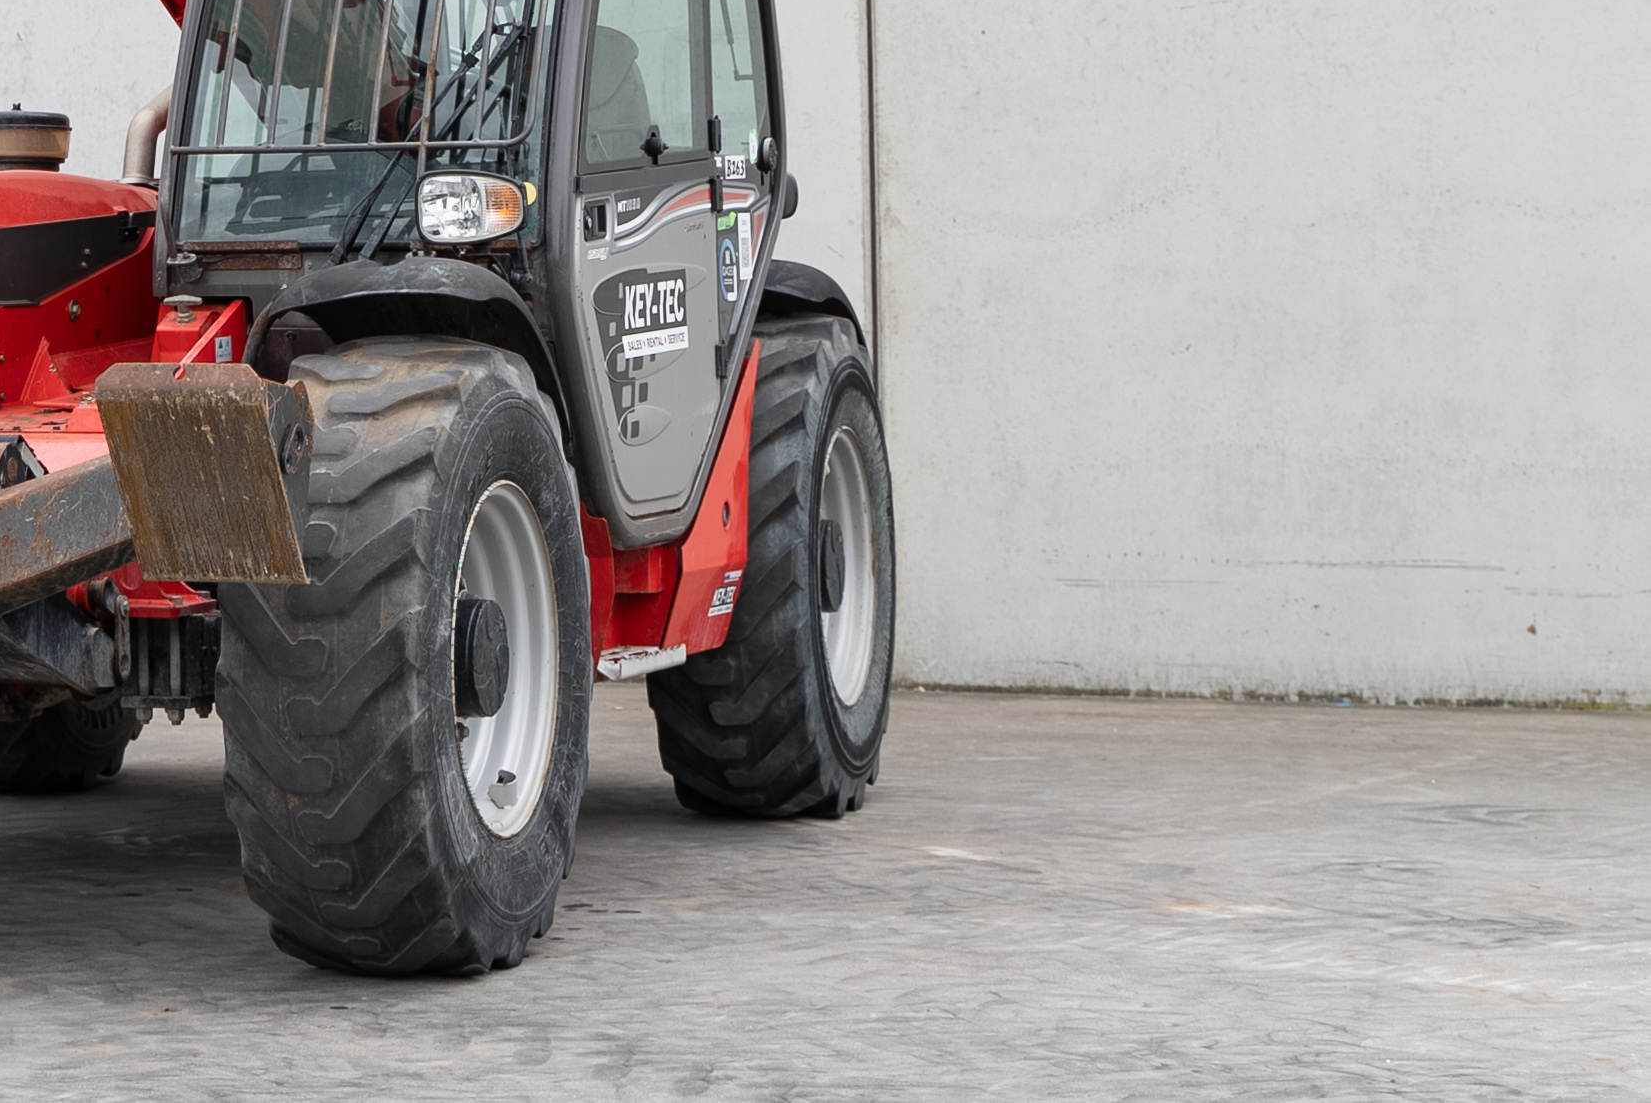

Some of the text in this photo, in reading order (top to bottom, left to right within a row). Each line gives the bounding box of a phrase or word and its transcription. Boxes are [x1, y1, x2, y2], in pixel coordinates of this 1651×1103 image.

[726, 159, 745, 178] B263
[624, 278, 685, 330] KEY-TEC
[627, 331, 685, 352] SALES RENTAL SERVICE
